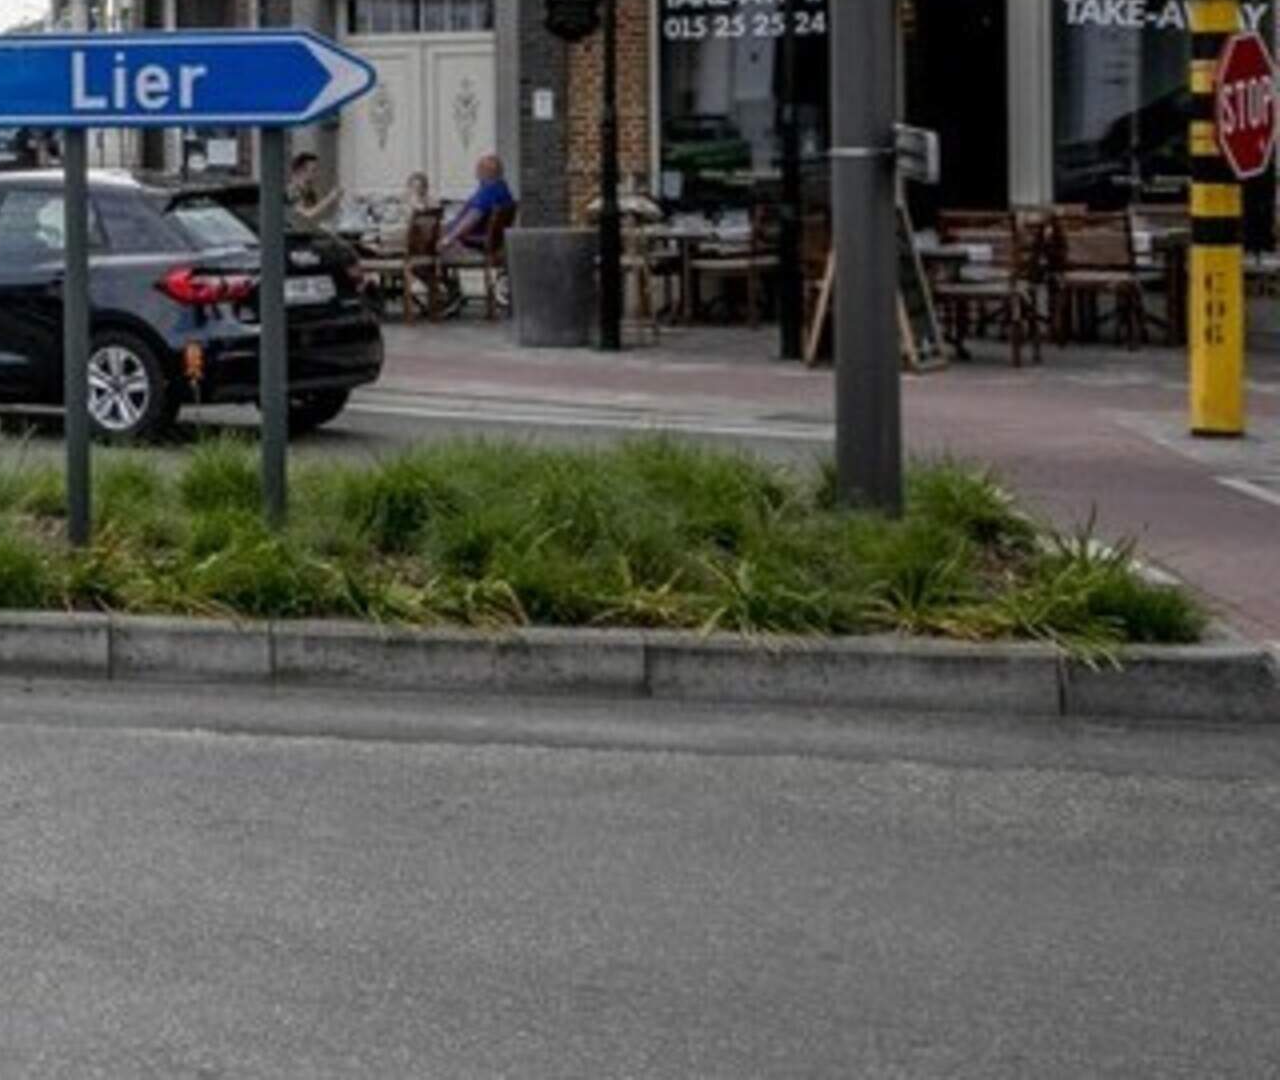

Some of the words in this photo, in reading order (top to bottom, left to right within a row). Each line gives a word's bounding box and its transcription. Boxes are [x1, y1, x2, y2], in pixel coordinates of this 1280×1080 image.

[664, 14, 707, 38] 015
[714, 13, 745, 37] 25
[754, 12, 786, 36] 25
[795, 10, 826, 34] 24
[71, 51, 208, 110] Lier
[1222, 75, 1272, 134] STOP
